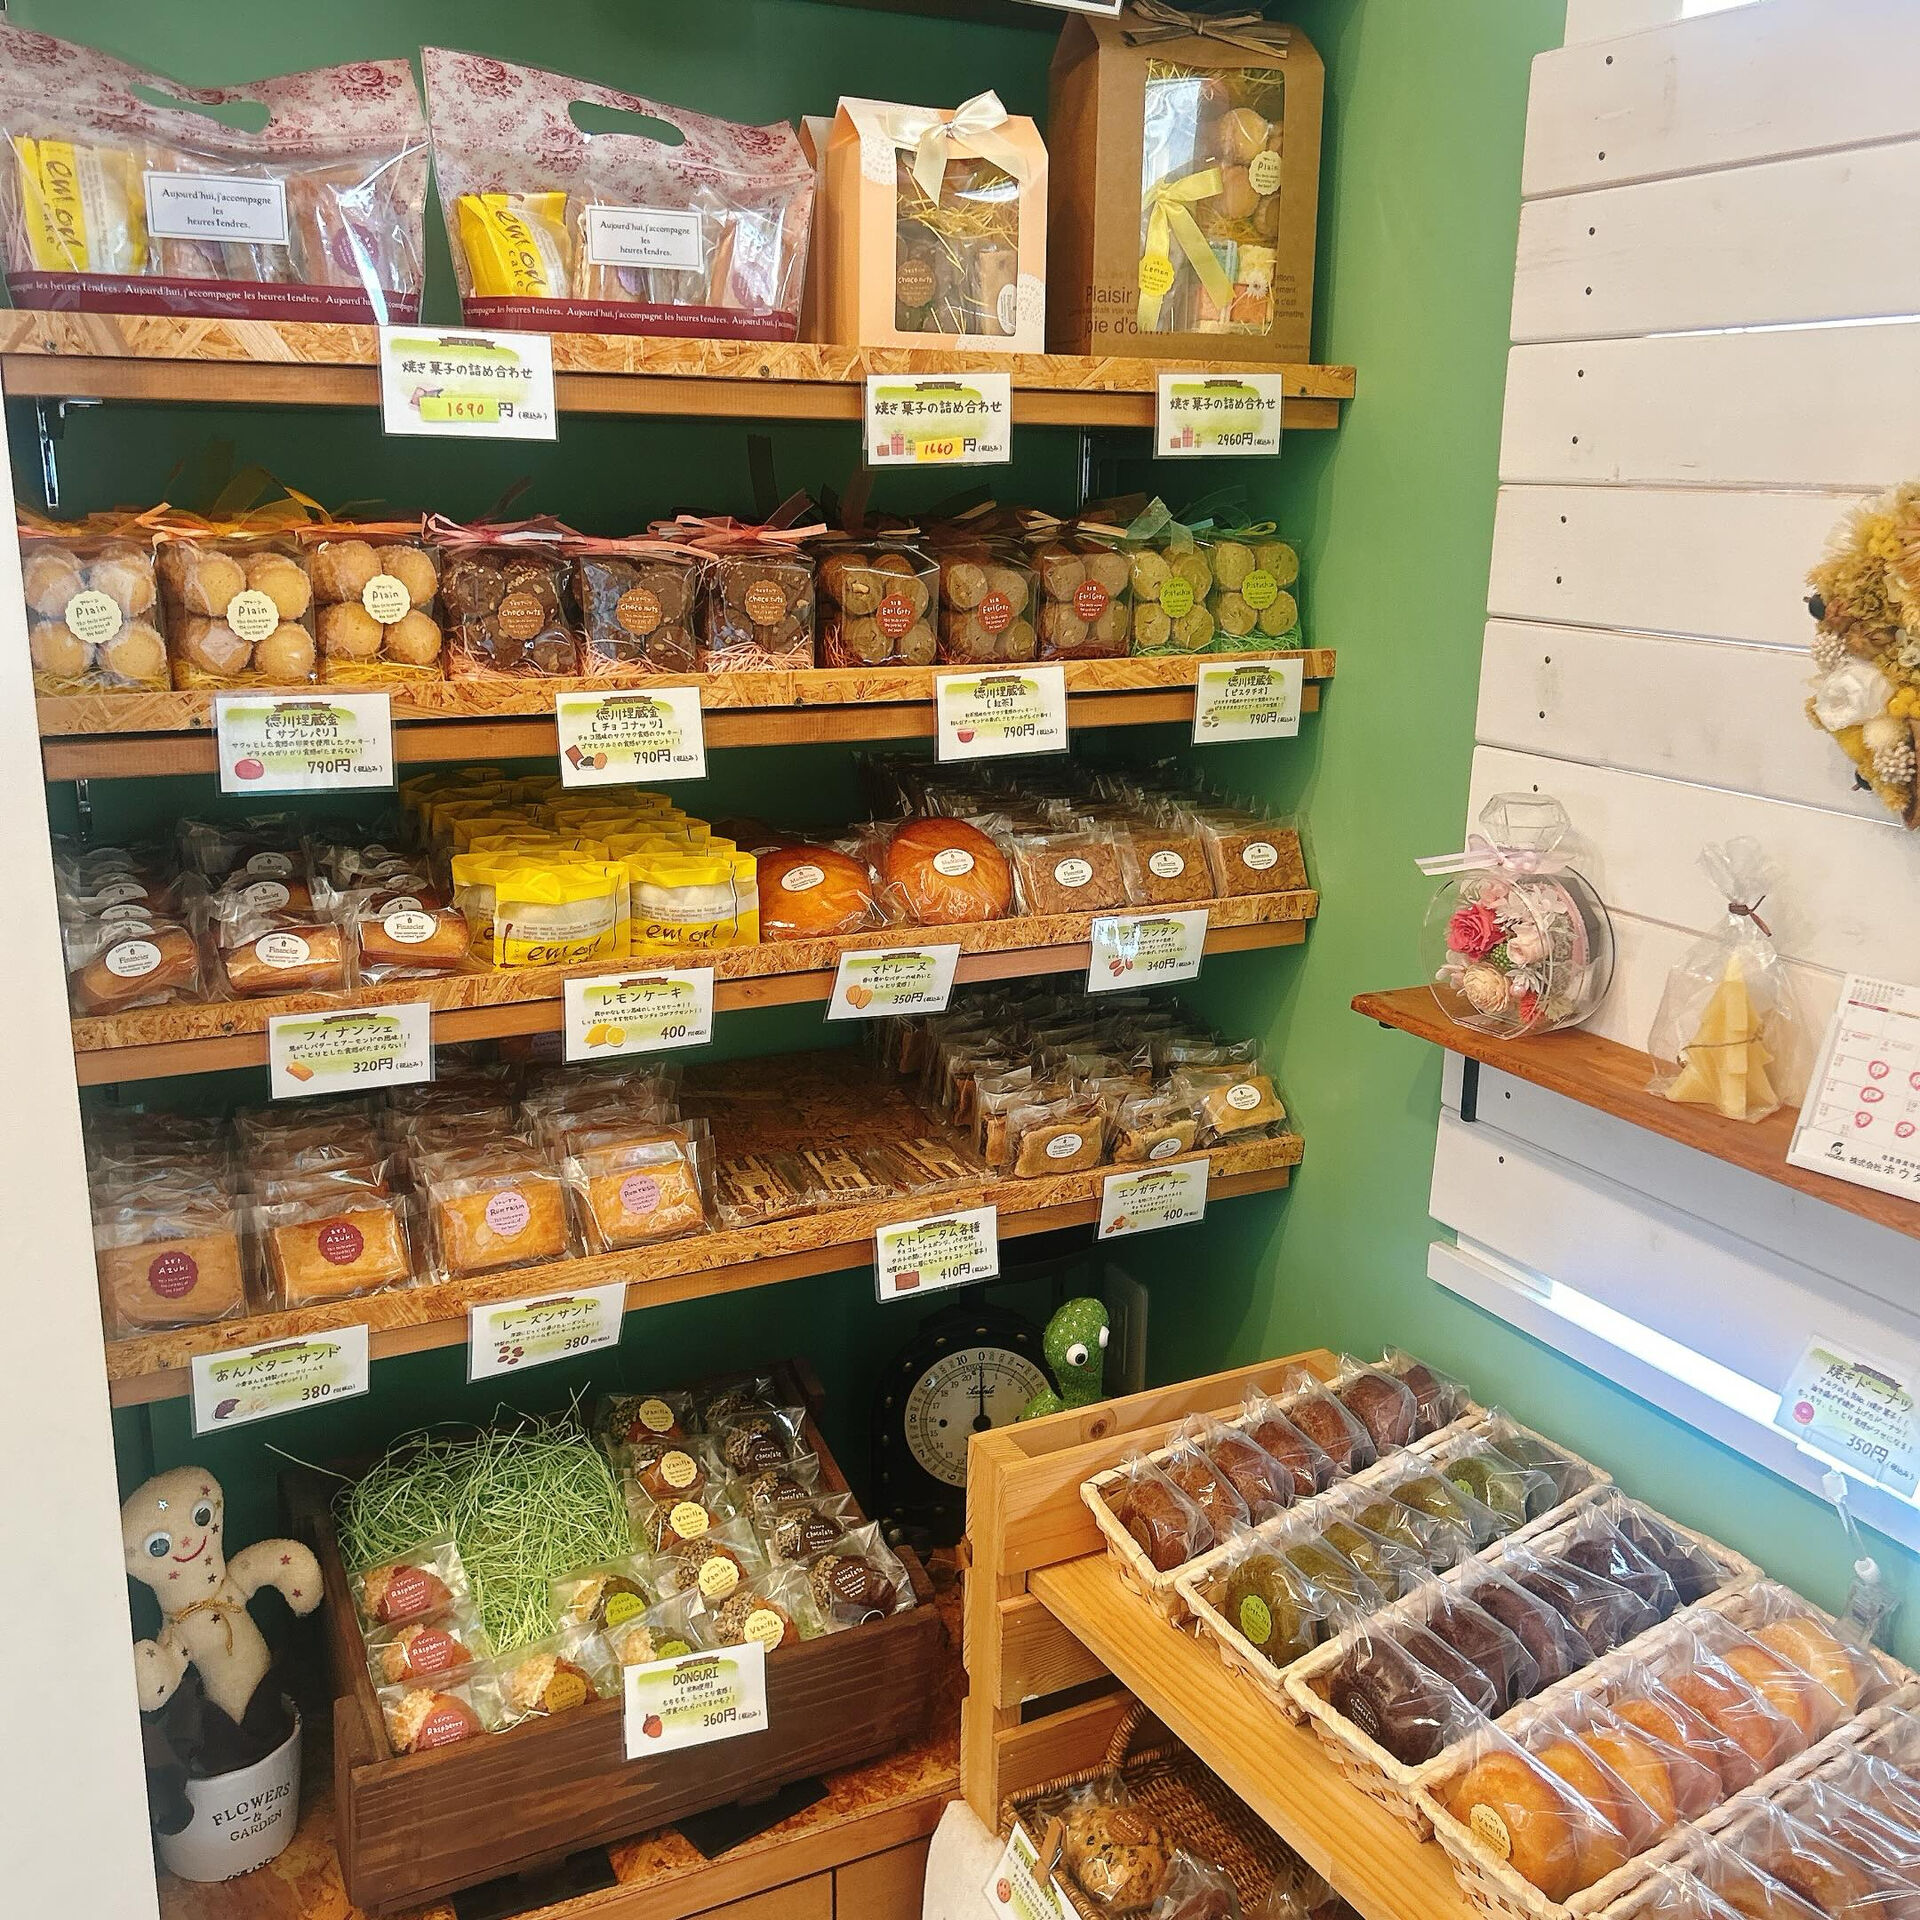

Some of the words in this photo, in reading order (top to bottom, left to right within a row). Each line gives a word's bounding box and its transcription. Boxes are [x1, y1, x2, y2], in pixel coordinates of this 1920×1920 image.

[212, 206, 223, 215] les
[187, 217, 214, 227] heures
[620, 245, 643, 255] heures
[36, 282, 48, 290] les
[50, 282, 80, 292] heures
[243, 291, 256, 300] les
[257, 293, 286, 302] heures
[1087, 286, 1133, 304] Plaisir
[506, 306, 531, 315] heures
[664, 313, 674, 321] les
[675, 314, 699, 323] heures
[402, 360, 533, 379] 焼き菓子の詰め合わせ
[448, 403, 484, 418] 1690
[498, 402, 514, 418] 円
[875, 400, 1002, 416] 焼き菓子の詰め合わせ
[1170, 397, 1275, 411] 焼き菓子の詰め合わせ
[923, 442, 954, 457] 1660
[963, 437, 977, 453] 円
[1217, 433, 1253, 447] 2960円
[372, 595, 399, 607] Plain
[76, 605, 107, 618] Plain
[239, 605, 268, 617] Plain
[974, 684, 1028, 699] 徳川埋蔵金
[265, 713, 341, 728] 徳川埋蔵金
[596, 705, 660, 721] 徳川埋蔵金
[1250, 711, 1277, 724] 790円
[1003, 723, 1035, 738] 790円
[634, 748, 670, 764] 790円
[308, 758, 350, 774] 790円
[871, 962, 927, 974] マドレーヌ
[1147, 957, 1176, 971] 340円
[603, 987, 682, 1006] レモンケーキ
[892, 992, 924, 1005] 350円
[304, 1024, 393, 1041] フィナンシェ
[660, 1025, 686, 1040] 400
[353, 1057, 393, 1073] 320円
[1118, 1180, 1187, 1198] エンガディナー
[1163, 1208, 1183, 1221] 400
[326, 1233, 354, 1243] Azuki
[896, 1221, 981, 1248] ストレータム各種
[159, 1266, 189, 1275] Azuki
[940, 1262, 970, 1279] 410円
[503, 1303, 597, 1331] レーズンサンド
[564, 1335, 589, 1350] 380
[215, 1346, 341, 1383] あんバターサンド
[301, 1384, 331, 1401] 380
[1826, 1363, 1914, 1413] 焼きドーナツ
[754, 1451, 782, 1461] Chocolate
[1846, 1433, 1889, 1464] 350円
[666, 1459, 691, 1470] Vanilla
[675, 1511, 702, 1523] Vanilla
[805, 1529, 834, 1539] Chocolate
[703, 1565, 731, 1584] Vanilla
[834, 1567, 864, 1586] Chocolate
[391, 1580, 425, 1598] Raspberry
[749, 1620, 778, 1634] Vanilla
[412, 1640, 446, 1656] Raspberry
[673, 1666, 719, 1686] DONGURI
[703, 1707, 737, 1727] 360円
[427, 1720, 464, 1735] Raspberry
[211, 1782, 291, 1826] FLOWERS
[229, 1808, 283, 1842] GARDEN
